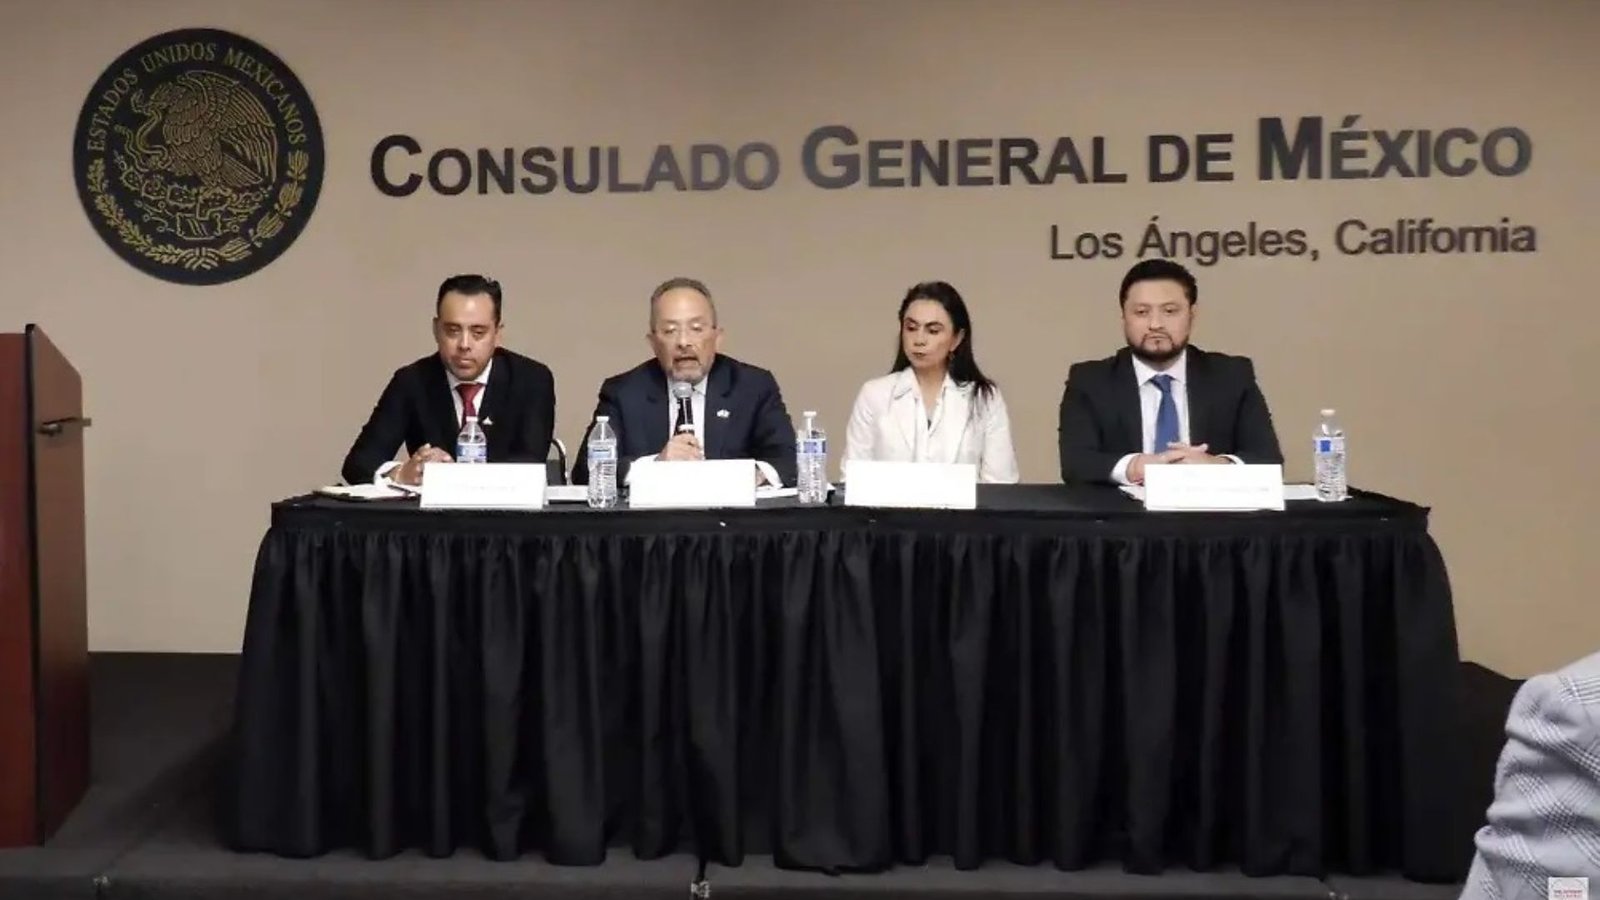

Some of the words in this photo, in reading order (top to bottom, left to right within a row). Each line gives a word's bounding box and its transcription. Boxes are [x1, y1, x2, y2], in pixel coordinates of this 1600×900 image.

[88, 68, 138, 151] ESTADOS
[141, 43, 216, 72] UNIDOS
[224, 47, 308, 145] MEXICANOS
[370, 134, 779, 197] CONSULADO
[802, 126, 1128, 189] GENERAL
[1148, 133, 1234, 183] DE
[1258, 115, 1532, 181] MÉXICO
[1050, 225, 1124, 260] Los
[1136, 215, 1319, 266] Ángeles,
[1335, 216, 1537, 256] California
